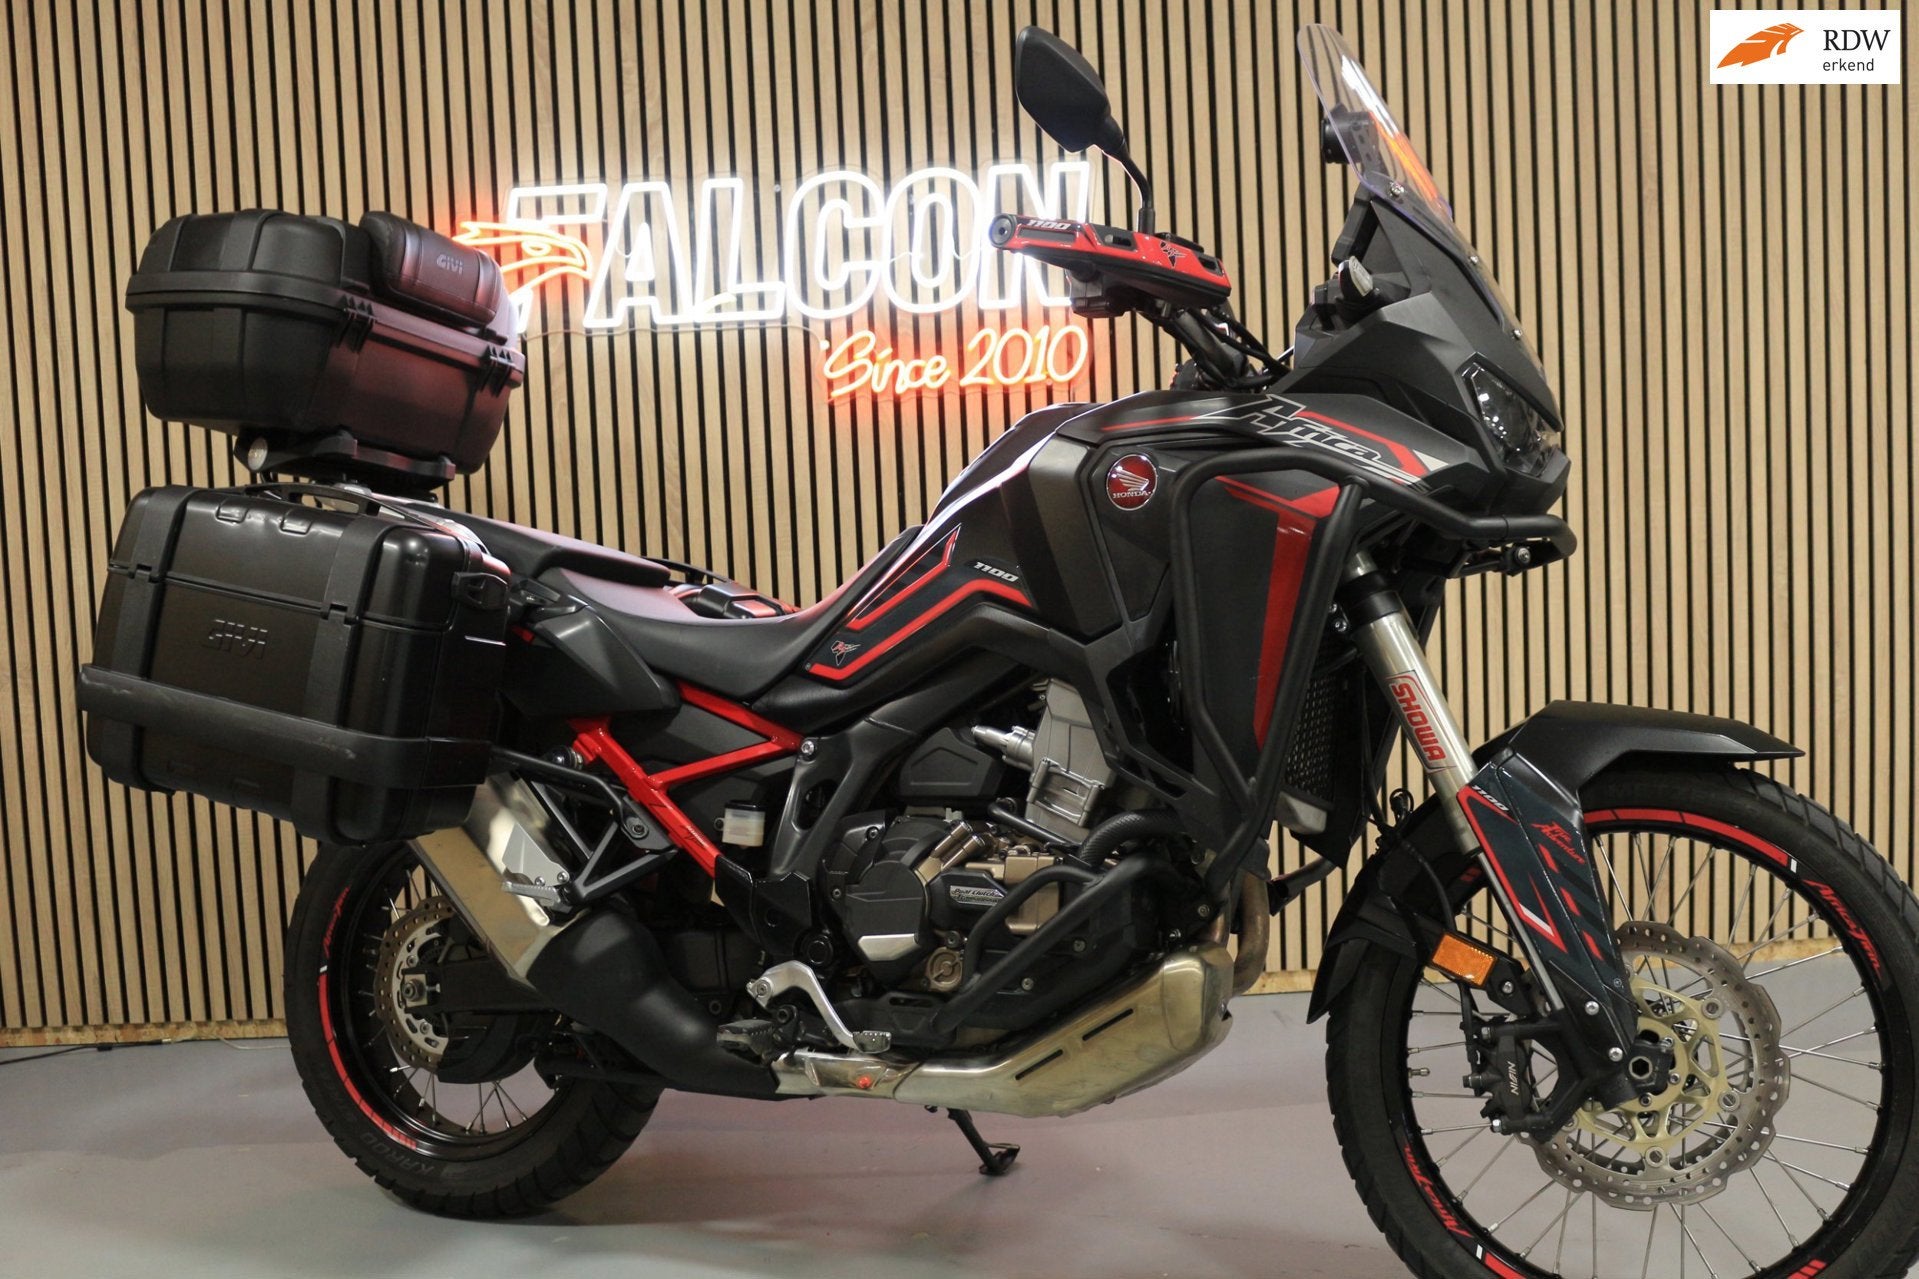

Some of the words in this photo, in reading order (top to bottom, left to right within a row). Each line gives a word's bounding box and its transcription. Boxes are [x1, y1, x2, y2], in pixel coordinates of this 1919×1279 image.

[1026, 219, 1072, 230] 1100
[507, 161, 1091, 330] FALCON
[823, 329, 951, 398] Since
[959, 324, 1090, 388] 2010
[1112, 490, 1149, 499] HONDA
[973, 561, 1019, 582] 1100
[1389, 682, 1447, 762] SHOWA
[1471, 784, 1510, 811] 1100
